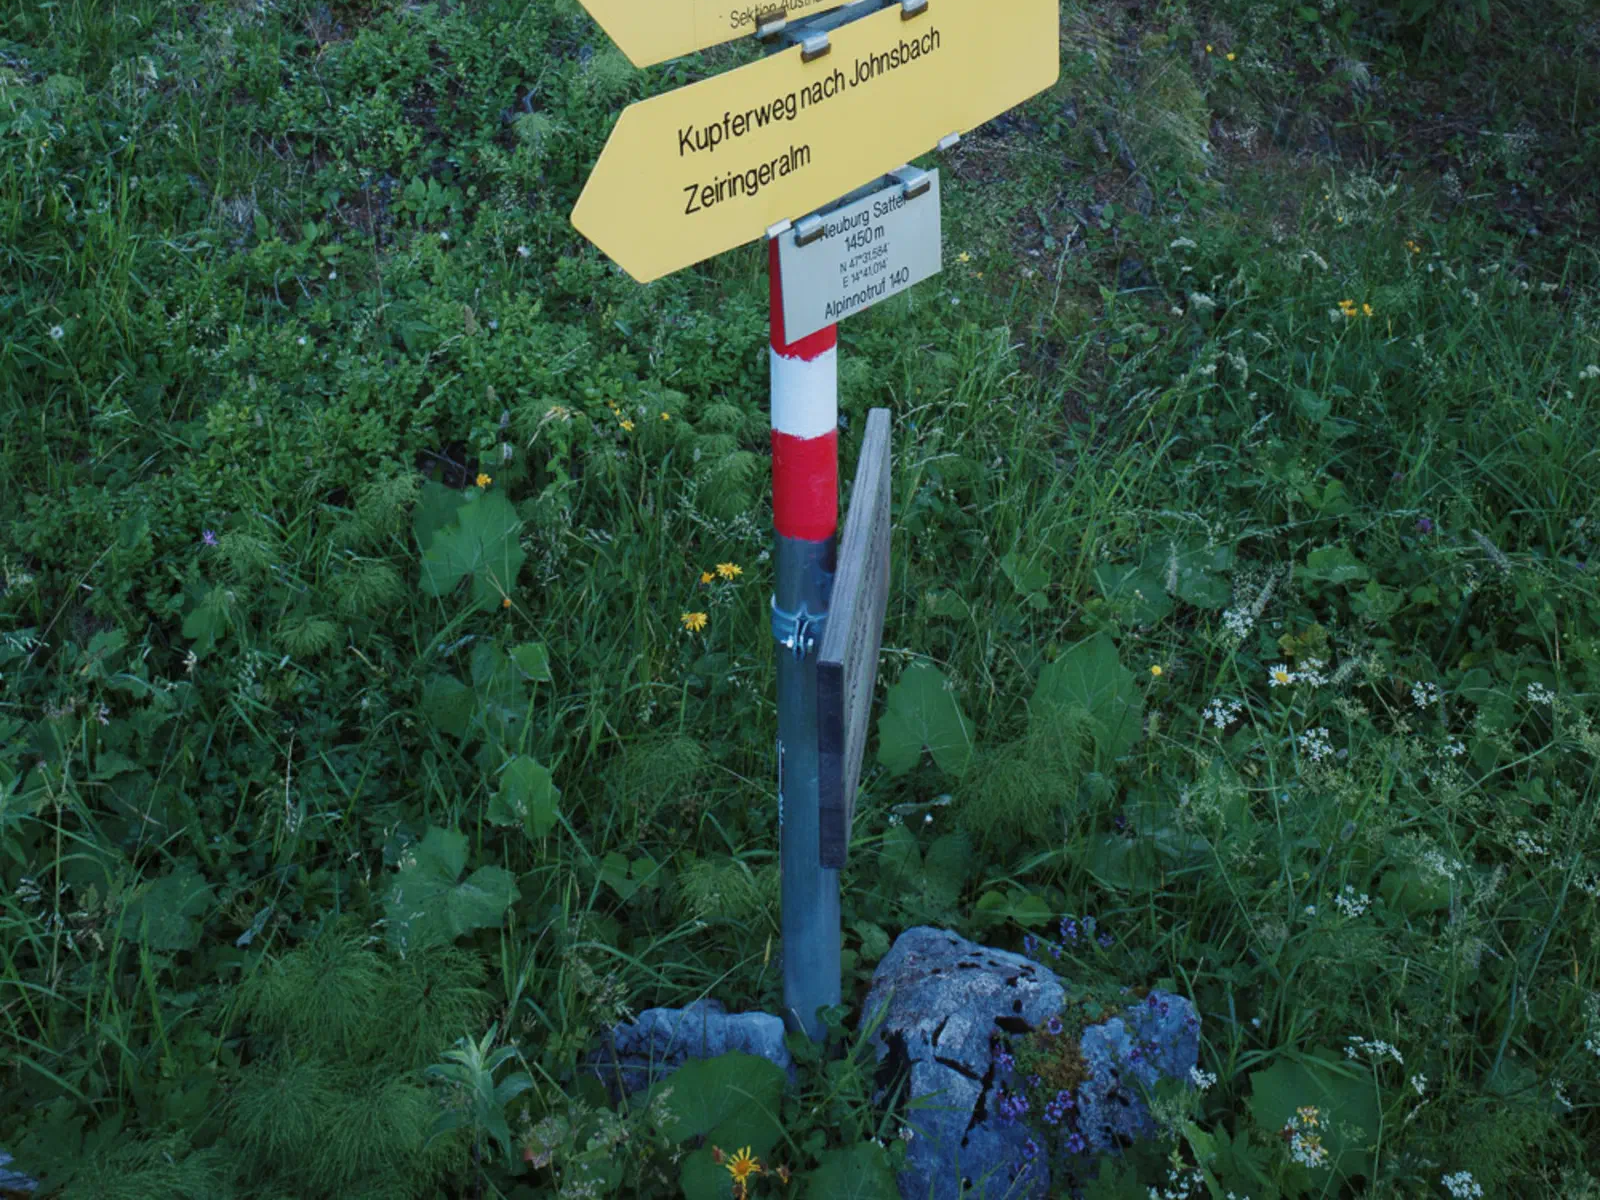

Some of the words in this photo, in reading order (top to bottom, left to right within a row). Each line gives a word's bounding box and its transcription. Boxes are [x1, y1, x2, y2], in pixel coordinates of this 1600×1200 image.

[678, 92, 797, 157] Kupferweg
[800, 68, 846, 109] nach
[849, 26, 941, 87] Johnsbach
[683, 144, 811, 215] Zeiringeralm
[845, 227, 873, 252] 1450
[875, 225, 885, 239] m
[840, 261, 847, 274] N
[842, 276, 848, 289] E
[824, 277, 886, 320] Alpinnotruf
[889, 266, 910, 289] 140
